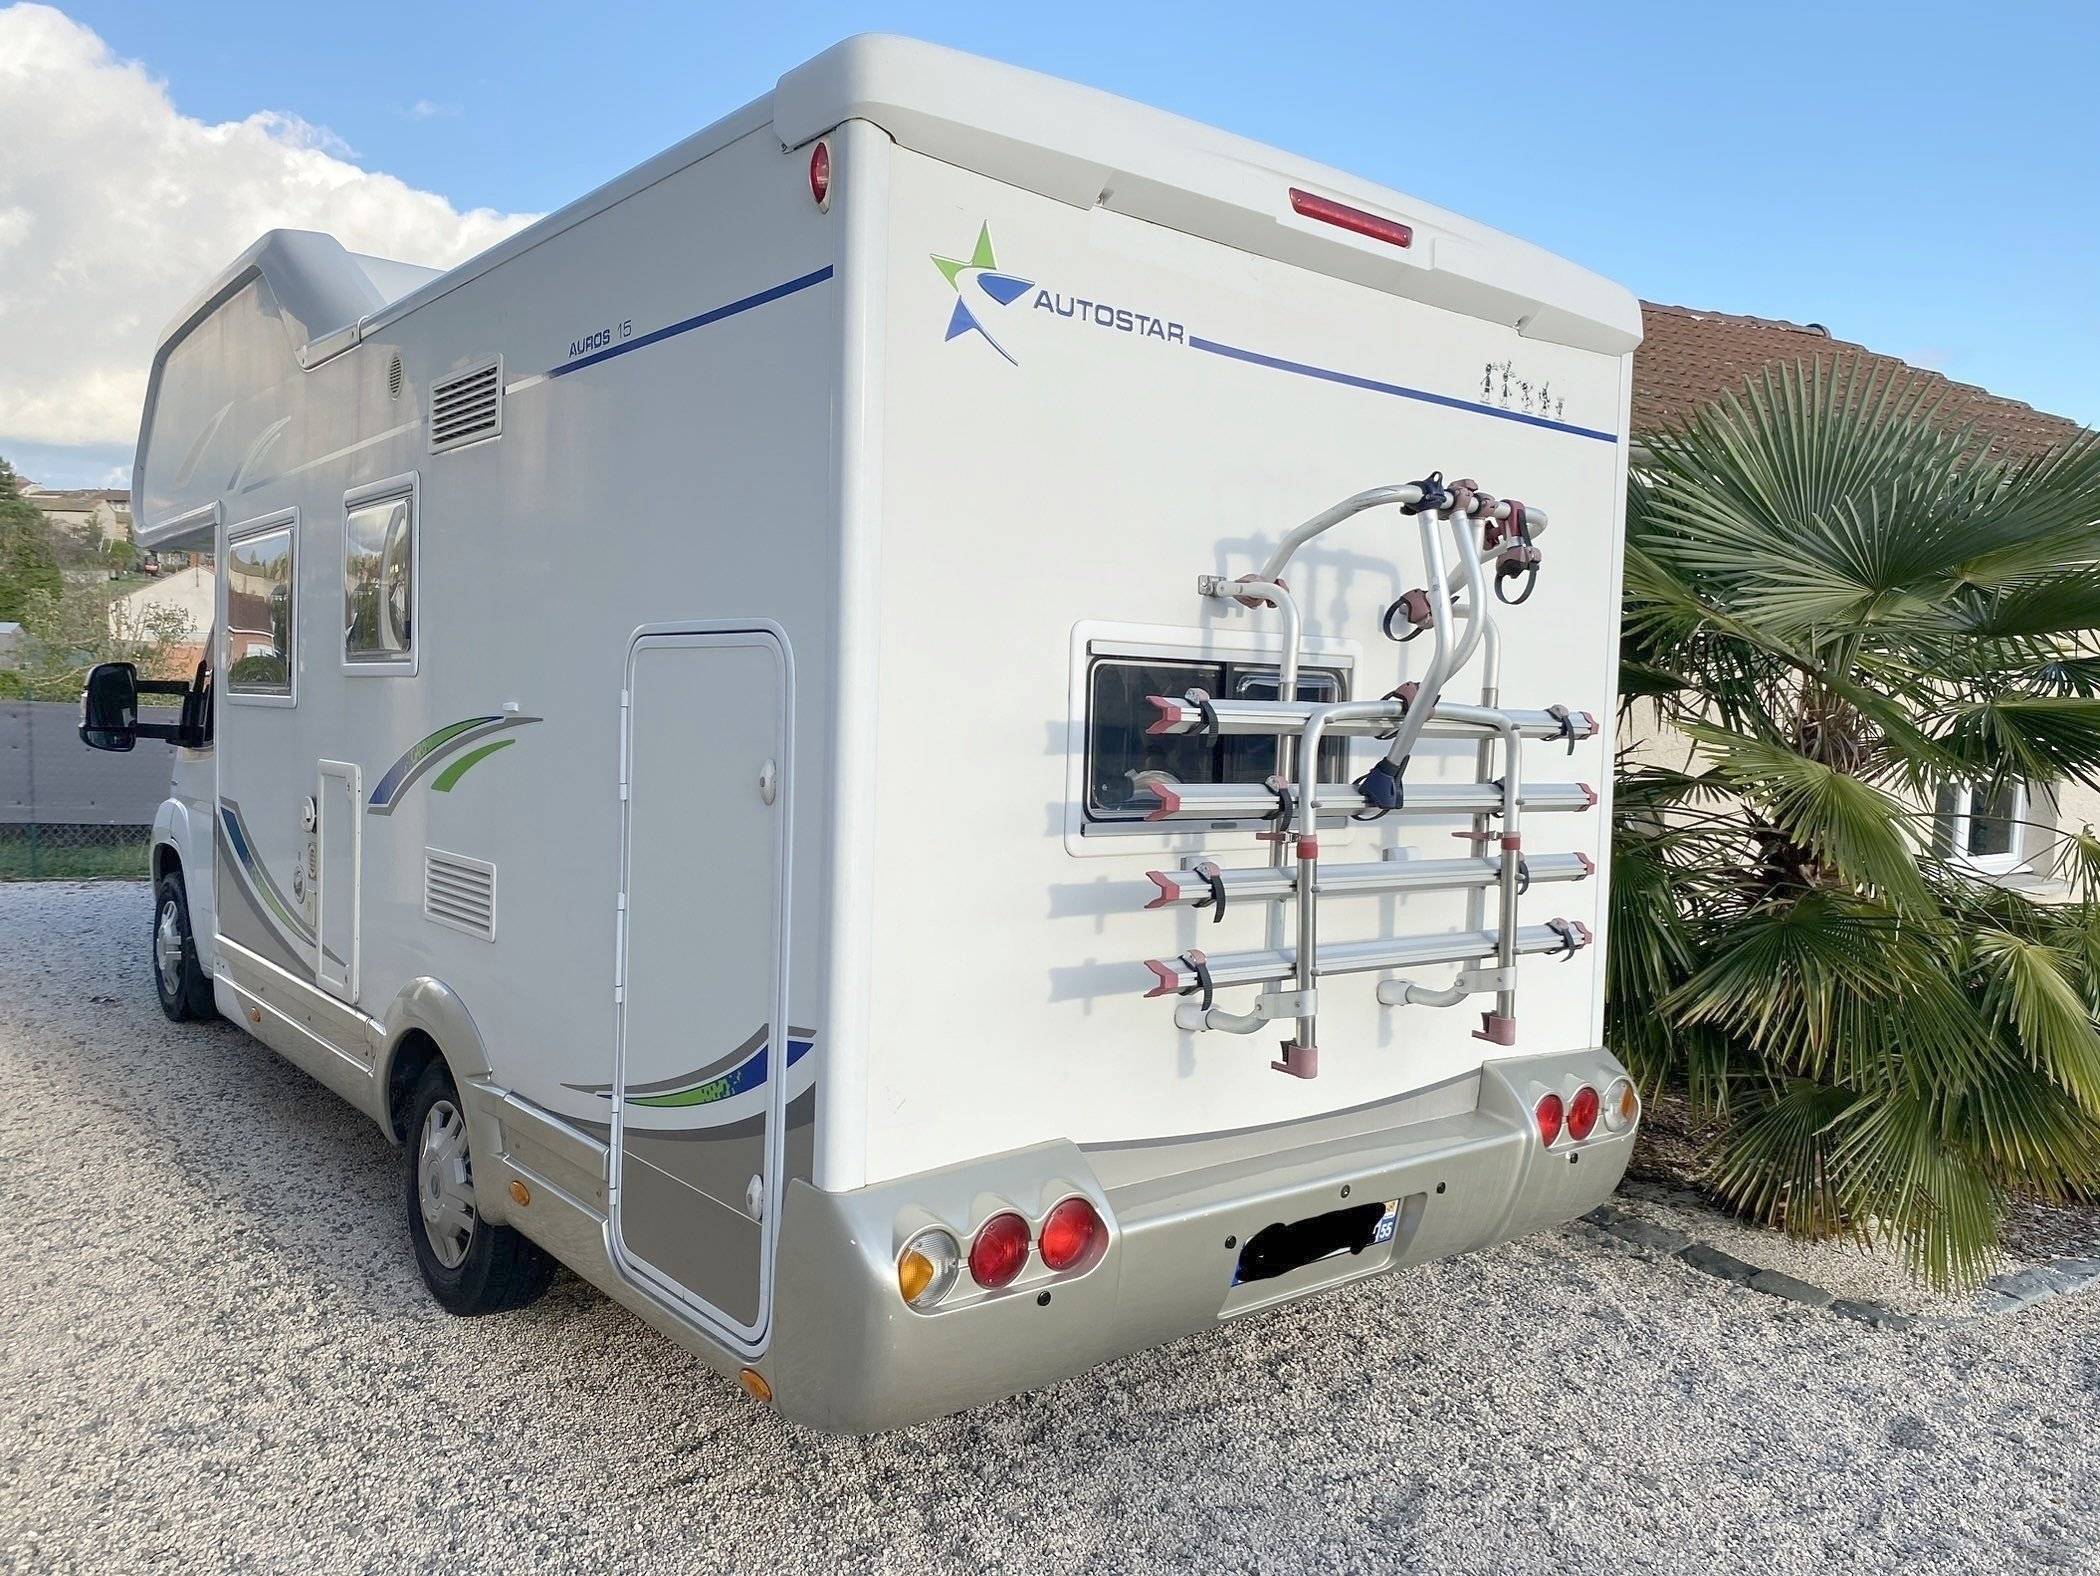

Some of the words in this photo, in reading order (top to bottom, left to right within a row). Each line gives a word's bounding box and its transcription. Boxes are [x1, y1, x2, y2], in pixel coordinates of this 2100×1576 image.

[568, 328, 610, 358] AUROS
[617, 319, 632, 338] 15
[1033, 289, 1185, 345] AUTOSTAR
